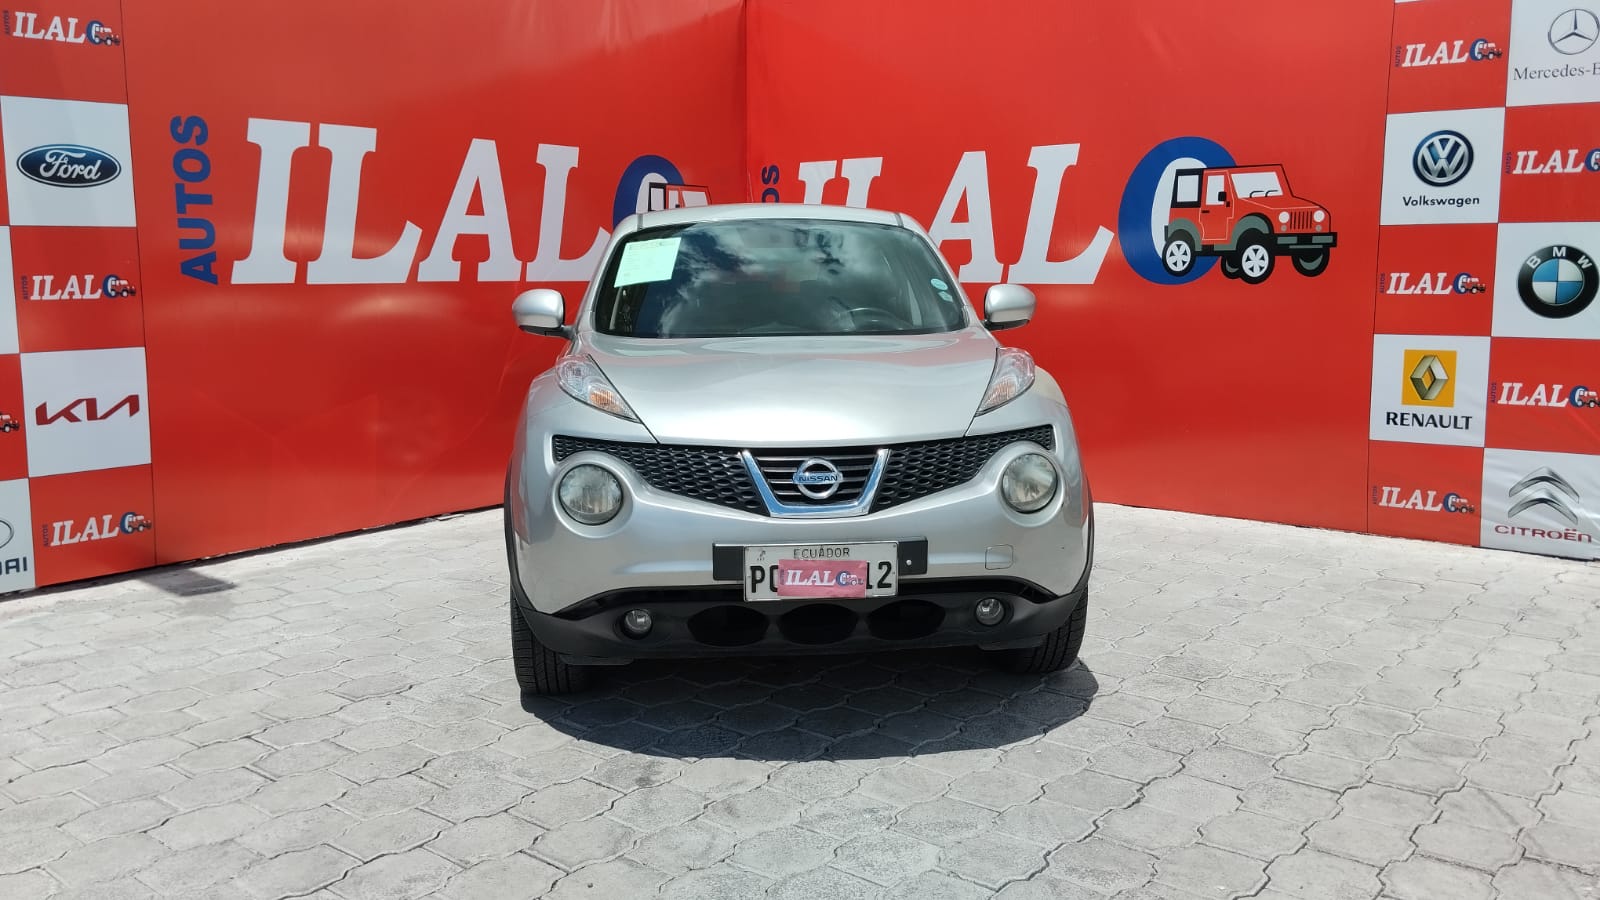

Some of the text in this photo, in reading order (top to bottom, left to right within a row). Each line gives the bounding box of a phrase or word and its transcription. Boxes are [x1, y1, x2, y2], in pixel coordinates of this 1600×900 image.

[40, 149, 102, 180] Ford
[170, 115, 219, 286] AUTOS
[1402, 195, 1480, 208] Volkswagen
[35, 394, 140, 426] KIA
[1386, 411, 1473, 430] RENAULT
[793, 547, 851, 559] ECUADOR
[0, 556, 28, 576] AI
